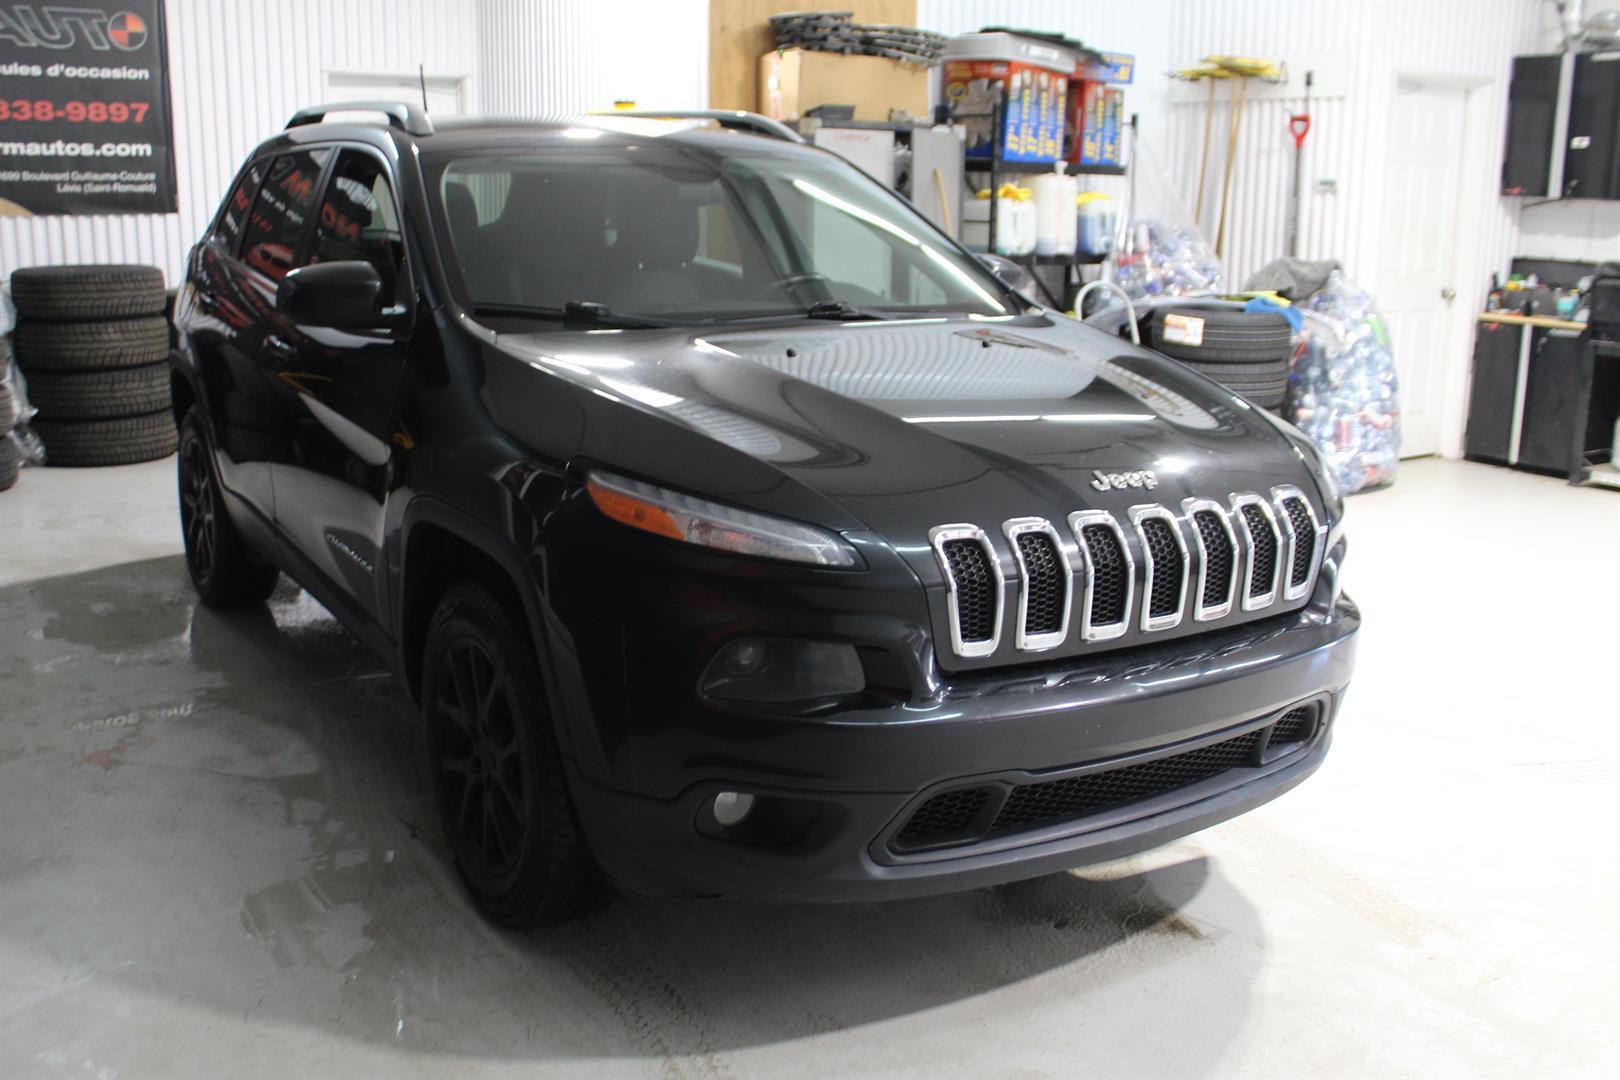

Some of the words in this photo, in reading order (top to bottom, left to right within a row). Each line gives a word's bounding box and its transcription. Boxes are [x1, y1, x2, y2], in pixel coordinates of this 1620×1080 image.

[0, 62, 42, 76] ules
[46, 63, 149, 80] d'occasion
[21, 170, 70, 182] Boulevard
[1090, 470, 1159, 491] Jeep
